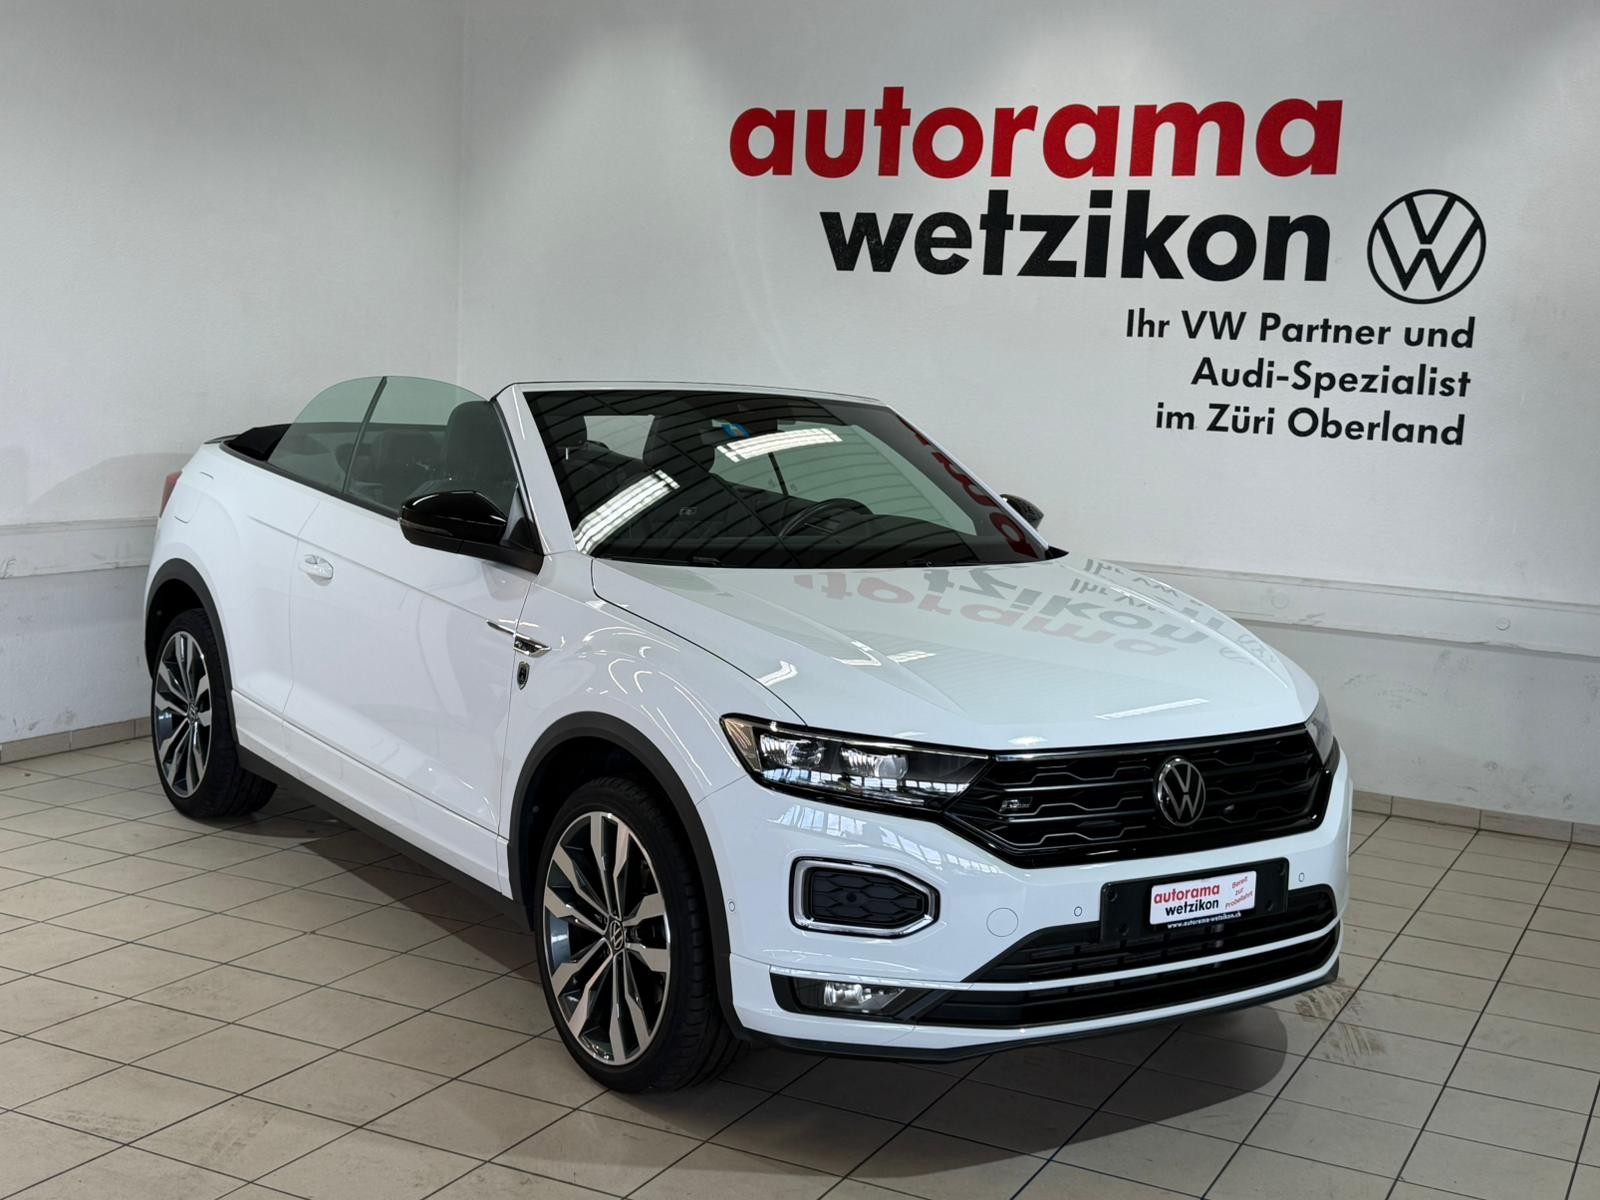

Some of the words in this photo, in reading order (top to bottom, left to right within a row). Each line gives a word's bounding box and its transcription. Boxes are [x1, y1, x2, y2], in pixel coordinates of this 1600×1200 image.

[730, 86, 1344, 179] autorama
[820, 189, 1331, 282] wetzikon
[1126, 308, 1170, 339] Ihr
[1181, 310, 1247, 342] VW
[1259, 312, 1393, 347] Partner
[1403, 316, 1476, 349] und
[1190, 356, 1472, 400] Audi-Spezialist
[1156, 401, 1195, 432] im
[1206, 403, 1275, 436] Züri
[1287, 407, 1466, 447] Oberland
[1154, 884, 1220, 904] autorama
[1165, 899, 1219, 916] wetzikon
